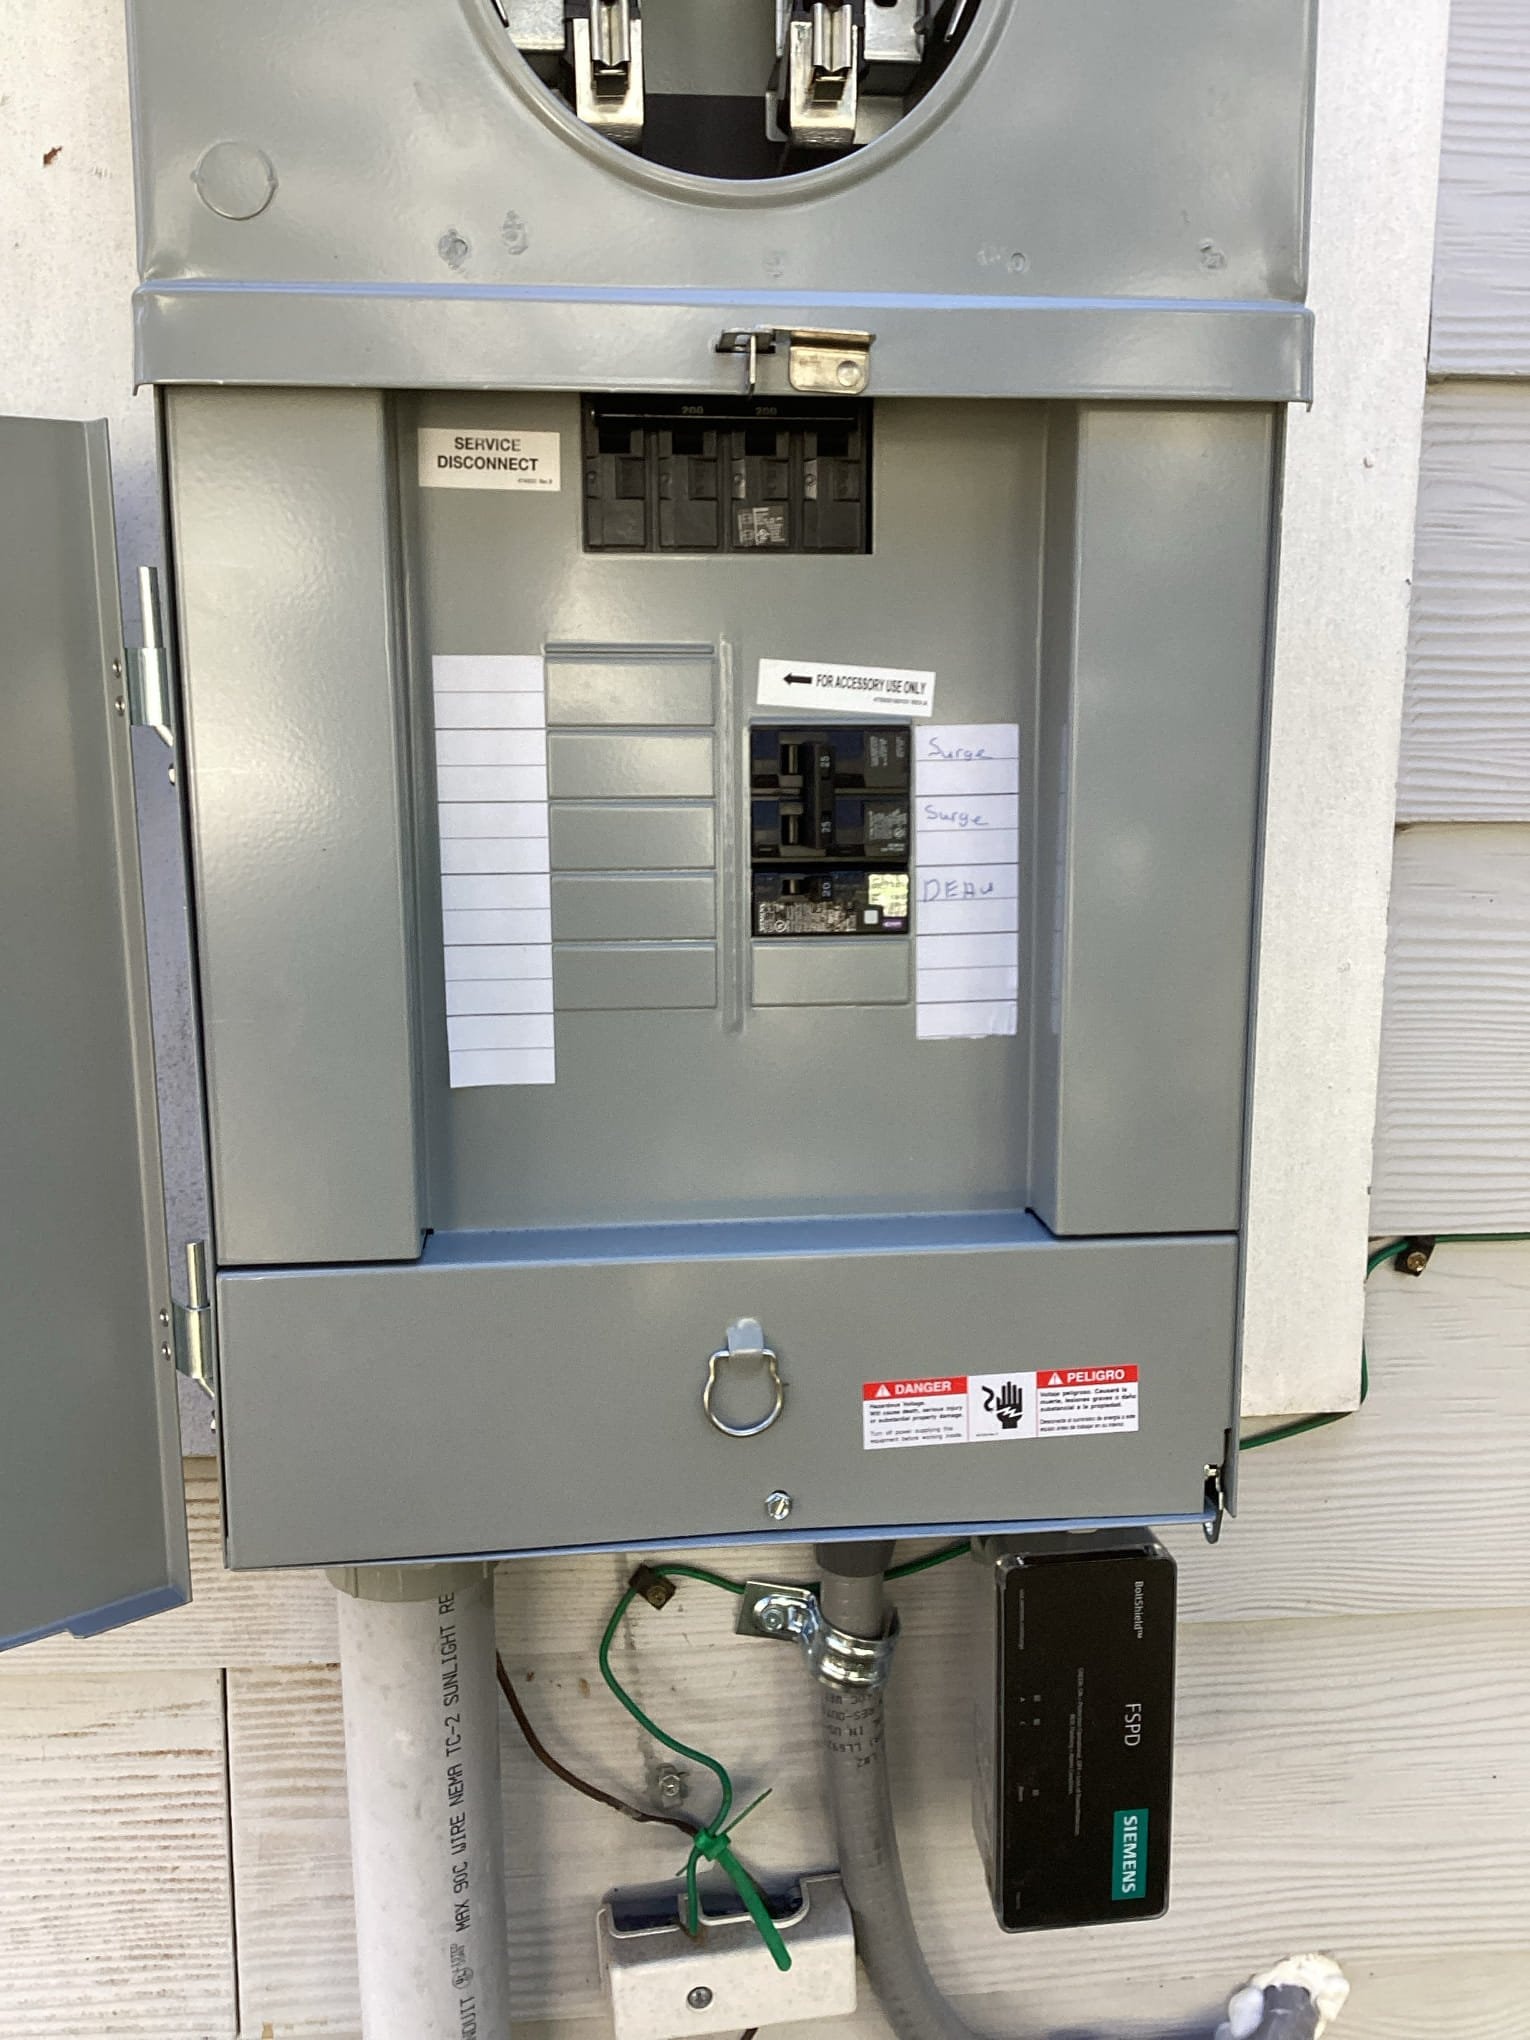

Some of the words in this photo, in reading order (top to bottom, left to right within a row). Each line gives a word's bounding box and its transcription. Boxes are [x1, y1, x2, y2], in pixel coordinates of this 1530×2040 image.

[454, 436, 521, 452] SERVICE
[437, 455, 539, 471] DISCONNECT
[815, 674, 833, 688] FOR
[834, 676, 885, 692] ACCESSORY
[886, 680, 903, 693] USE
[903, 682, 927, 695] ONLY
[928, 737, 992, 760] Surge
[924, 804, 989, 827] Surge
[895, 1380, 952, 1394] DANGER
[1067, 1369, 1126, 1384] PELIGRO
[440, 1621, 459, 1706] SUNLIGHT
[445, 1712, 461, 1757] TC-2
[1124, 1703, 1142, 1747] FSPD
[448, 1762, 464, 1807] NEMA
[450, 1811, 466, 1859] WIRE
[1122, 1815, 1138, 1894] SIEMENS
[452, 1861, 469, 1896] 90C
[454, 1898, 471, 1932] MAX
